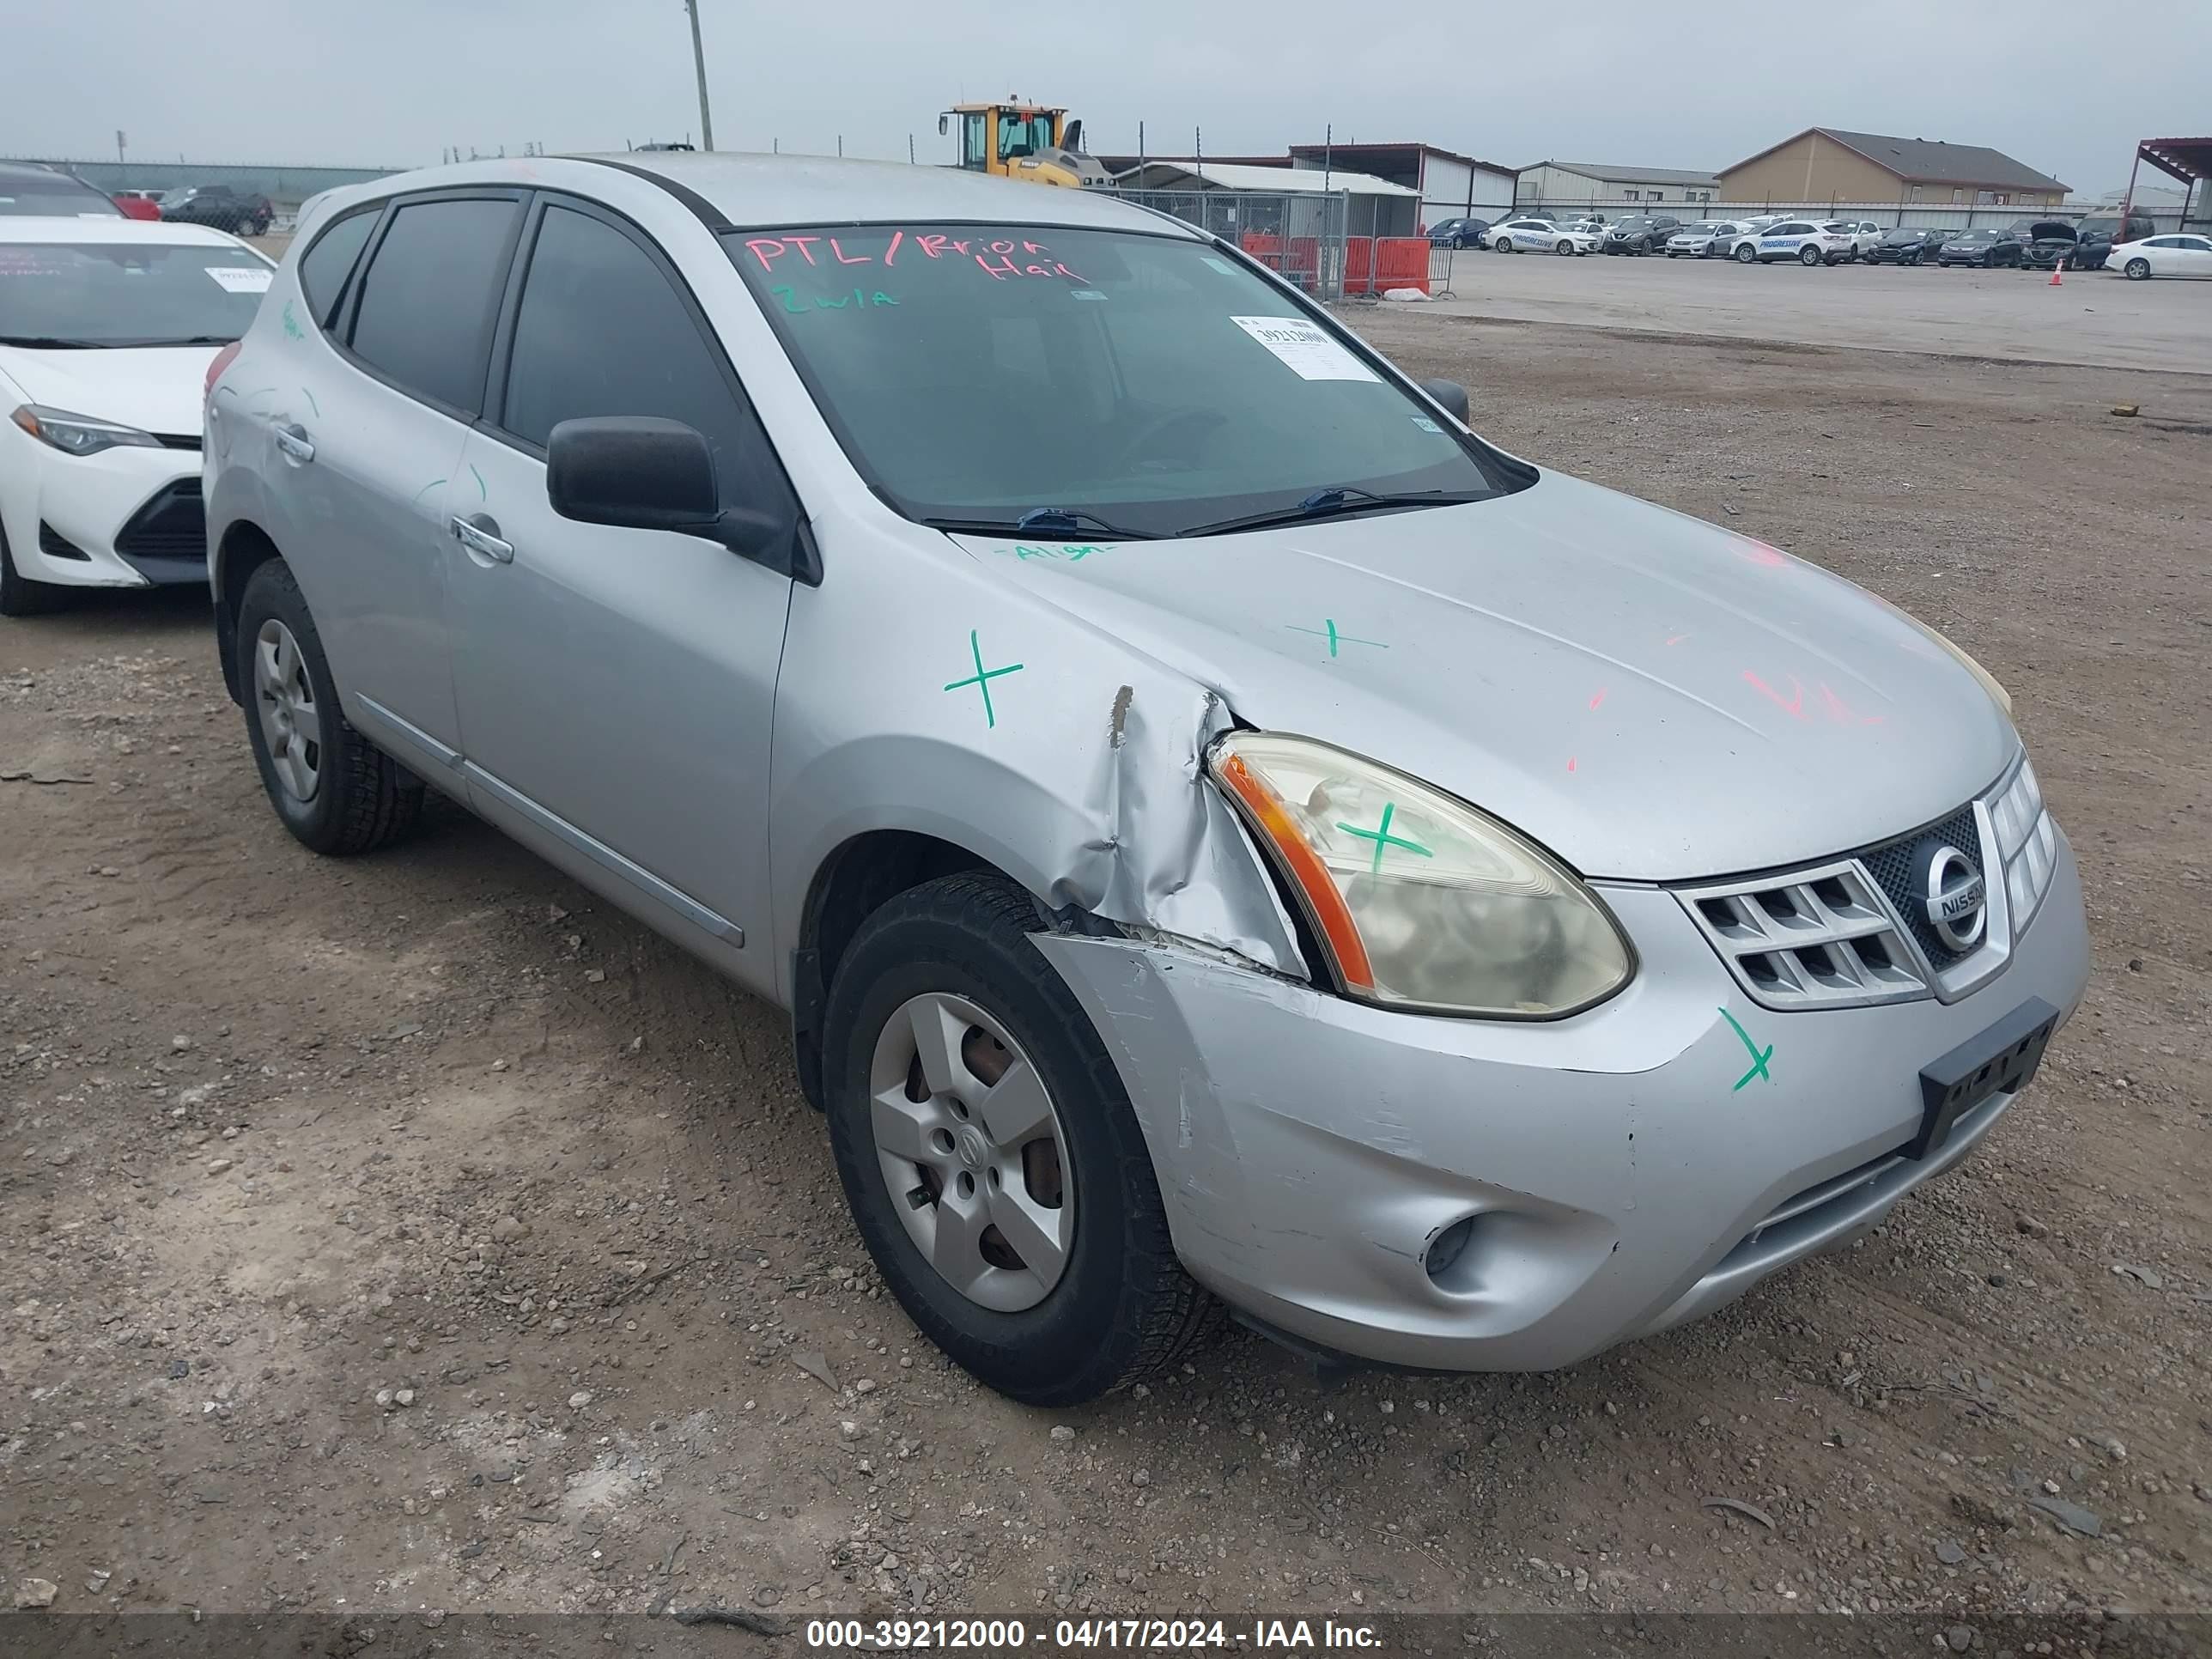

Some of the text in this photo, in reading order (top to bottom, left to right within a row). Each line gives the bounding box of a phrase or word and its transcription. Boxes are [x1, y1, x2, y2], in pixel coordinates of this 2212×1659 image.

[1512, 234, 1553, 248] PROGRESSIVE
[1759, 240, 1802, 248] PROGRESSIVE
[975, 256, 1091, 284] Hail
